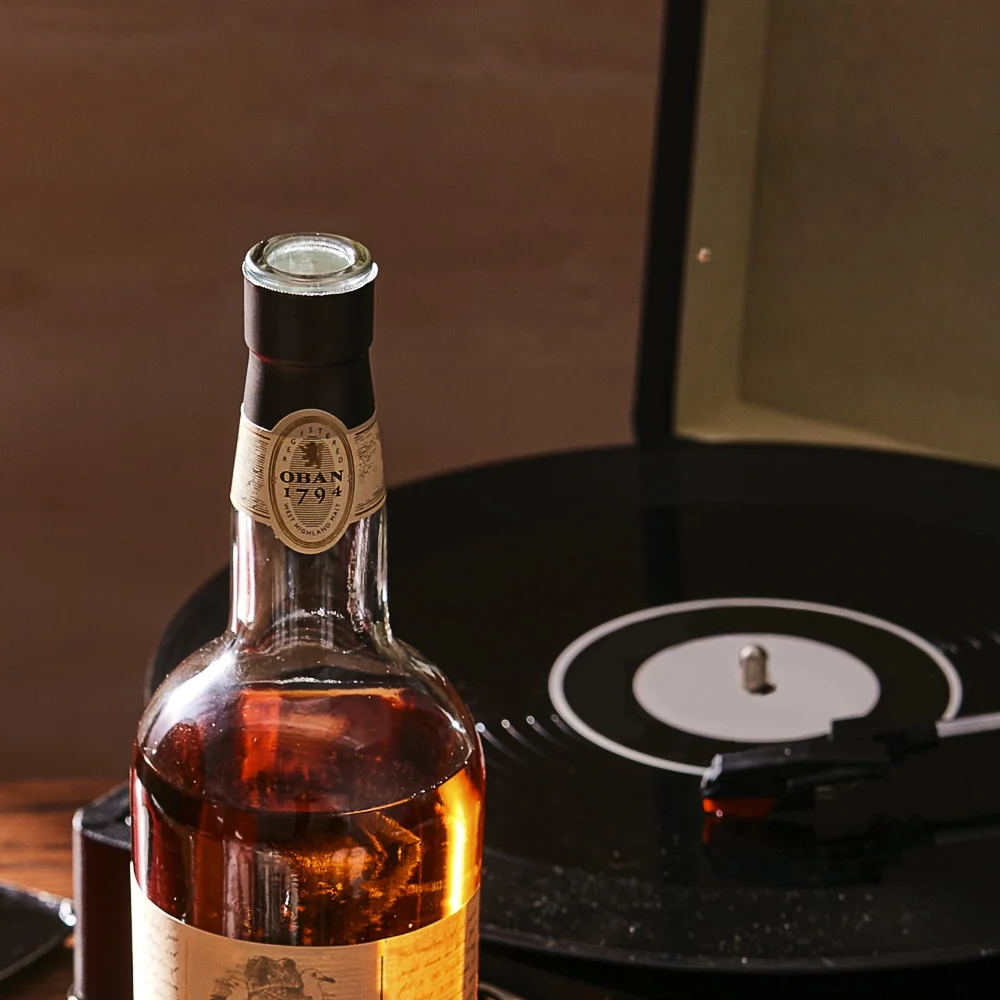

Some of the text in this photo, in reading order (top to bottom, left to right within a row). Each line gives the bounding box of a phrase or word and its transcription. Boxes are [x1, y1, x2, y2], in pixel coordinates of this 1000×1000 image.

[282, 426, 344, 463] REGISTERED
[279, 470, 344, 484] OBAN
[284, 485, 342, 505] 1794
[283, 502, 342, 536] WEST HIGHLAND MALT
